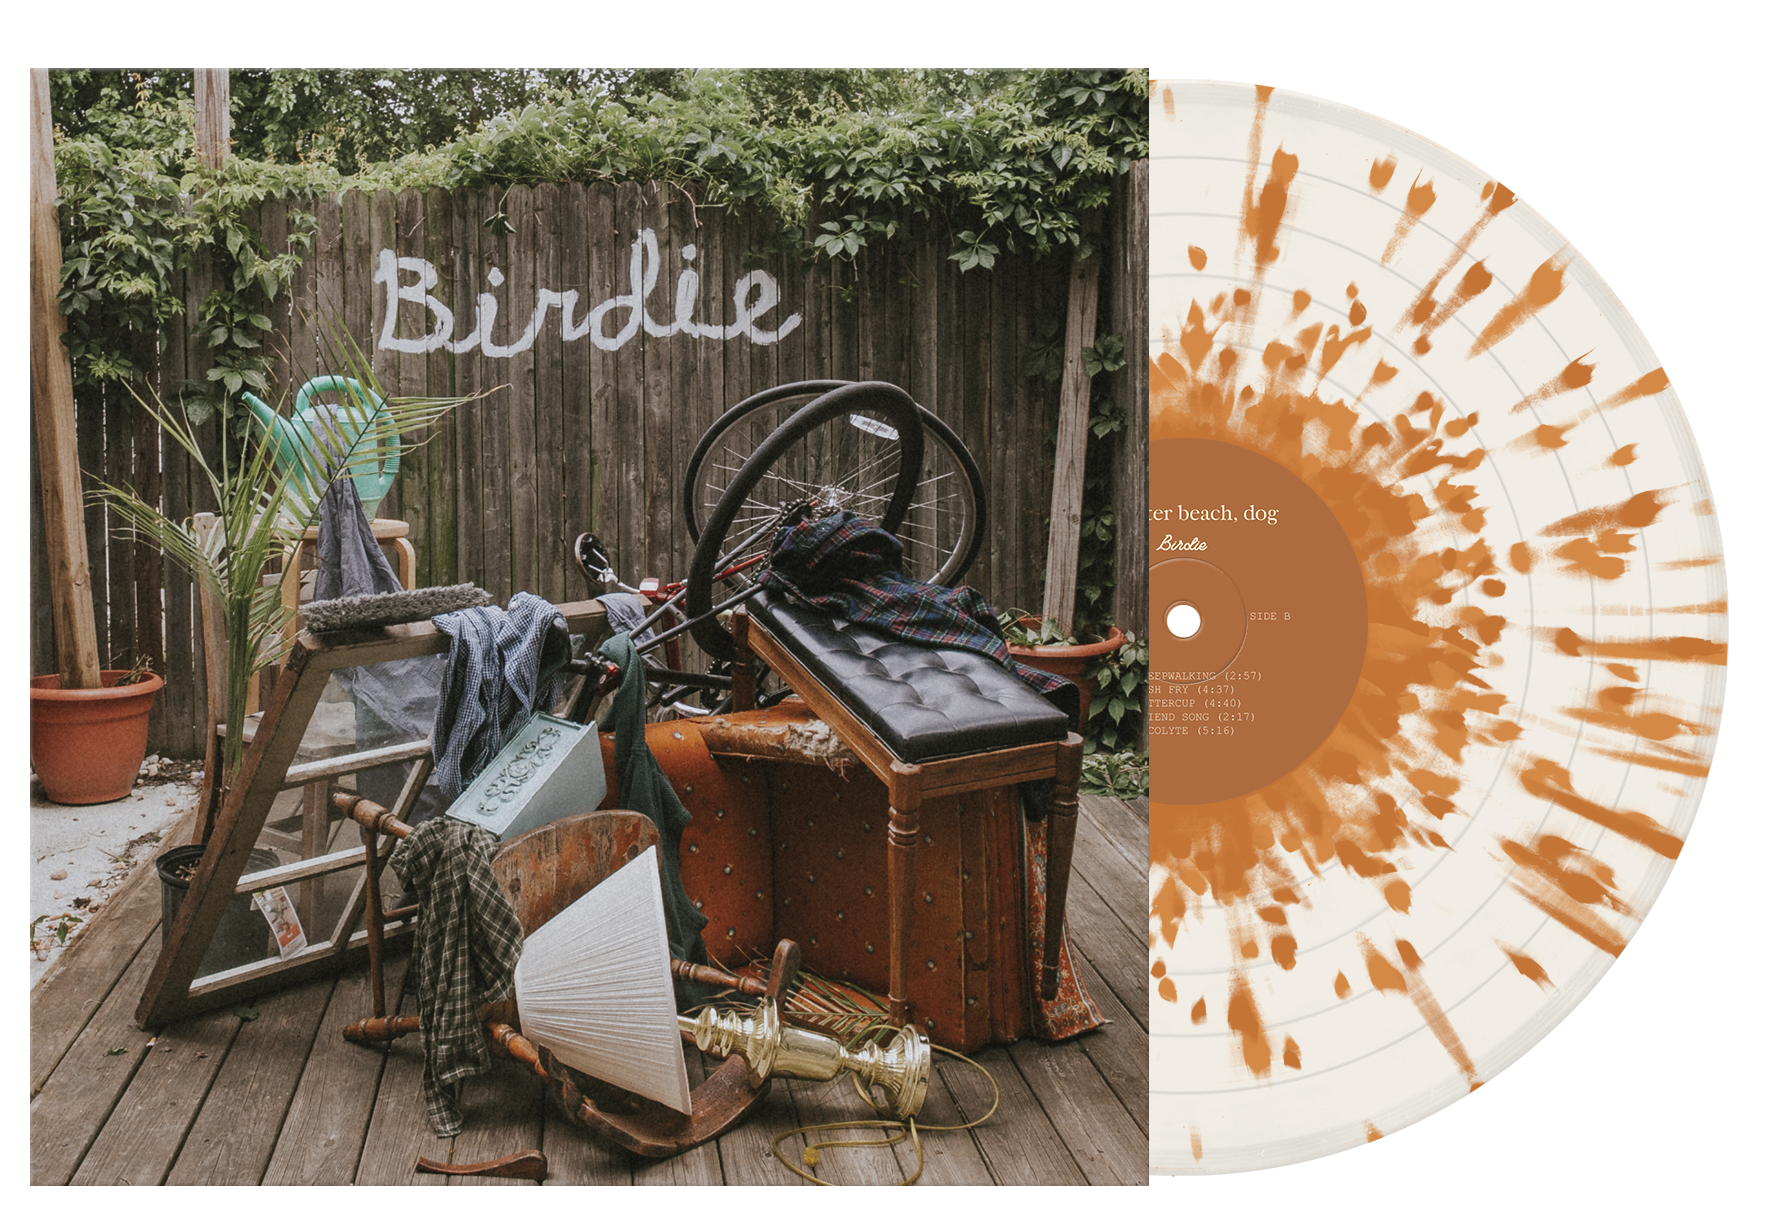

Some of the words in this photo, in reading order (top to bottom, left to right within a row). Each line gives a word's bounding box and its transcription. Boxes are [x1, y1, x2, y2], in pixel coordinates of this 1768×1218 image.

[373, 227, 803, 358] Birdie
[1177, 504, 1238, 523] beach,
[1243, 504, 1280, 526] dog
[1156, 534, 1208, 551] Birdie
[1249, 611, 1278, 621] SIDE
[1284, 611, 1291, 621] B
[1149, 671, 1216, 681] EEPWALKING
[1225, 671, 1262, 682] (2:57)
[1149, 685, 1161, 694] SH
[1168, 685, 1189, 694] FRY
[1197, 685, 1235, 695] (4:37)
[1149, 699, 1196, 708] TTERCUP
[1204, 698, 1242, 709] (4:40)
[1149, 712, 1176, 722] IEND
[1181, 712, 1210, 722] SONG
[1218, 712, 1255, 723] (2:17)
[1149, 726, 1189, 736] COLYTE
[1197, 726, 1235, 736] (5:16)
